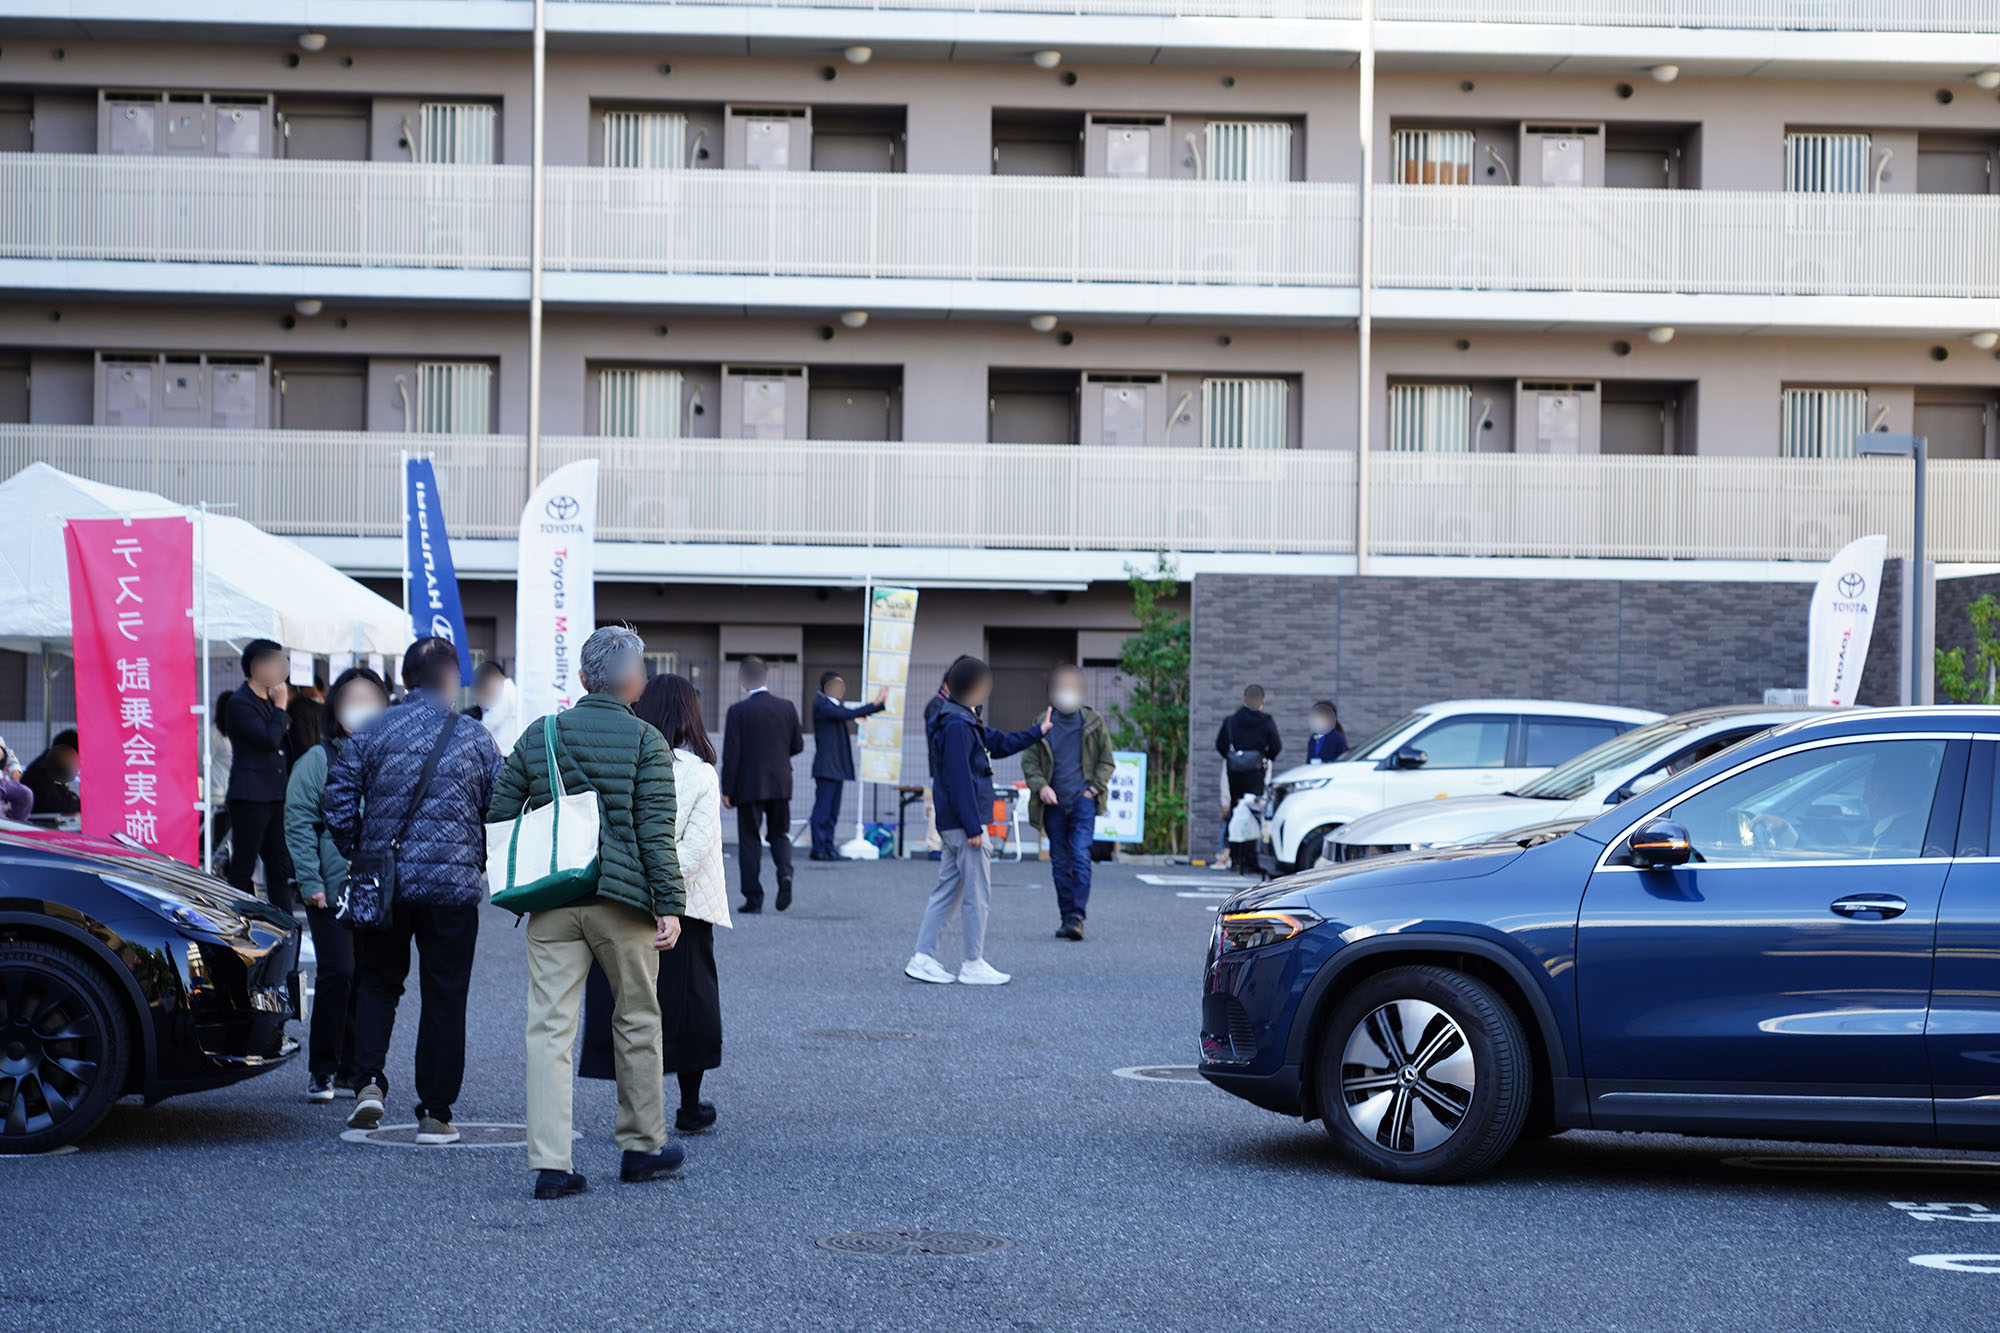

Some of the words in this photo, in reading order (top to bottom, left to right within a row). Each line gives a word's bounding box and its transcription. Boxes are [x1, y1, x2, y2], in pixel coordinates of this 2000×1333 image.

[415, 481, 443, 609] HYUNDAI
[539, 523, 584, 534] TOYOTA
[550, 547, 568, 609] Toyota
[1832, 602, 1868, 614] TOYOTA
[552, 616, 568, 692] Mobility
[1834, 628, 1852, 693] Toyota
